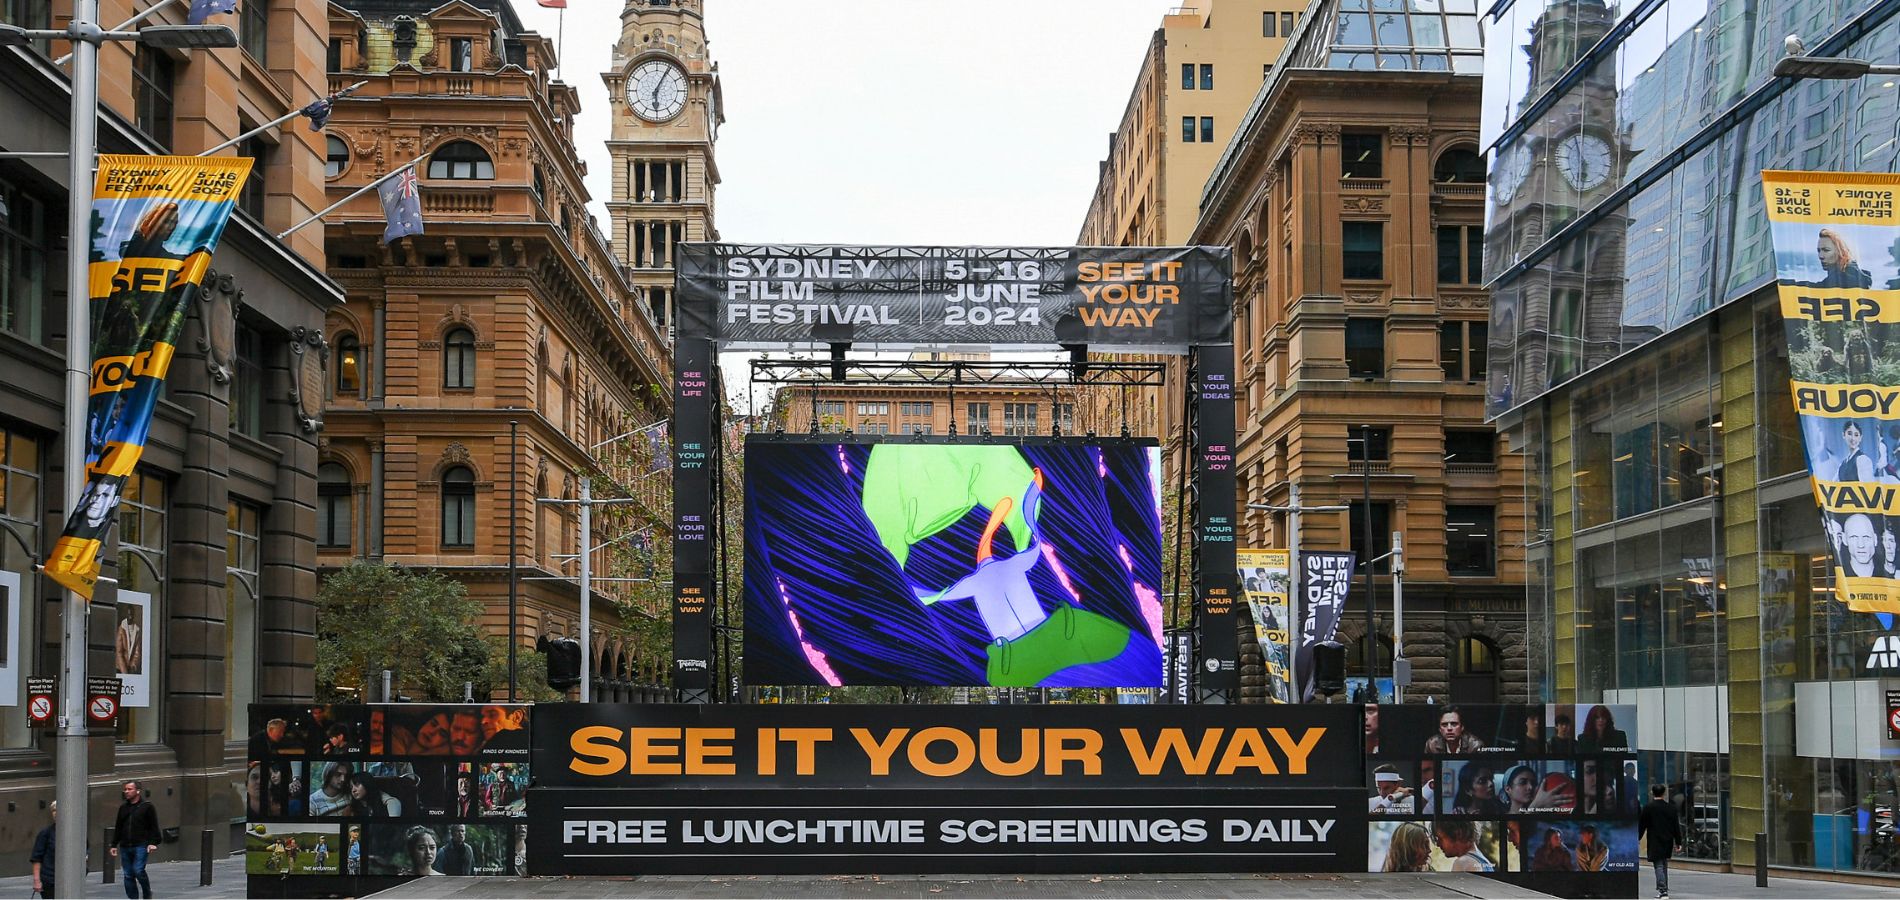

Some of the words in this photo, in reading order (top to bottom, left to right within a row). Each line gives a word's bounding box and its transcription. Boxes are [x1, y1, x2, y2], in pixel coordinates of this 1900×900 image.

[106, 176, 143, 184] FILM
[109, 169, 171, 177] SYDNEY
[194, 179, 235, 188] JUNE
[104, 184, 173, 192] FESTIVAL
[727, 257, 878, 279] SYDNEY
[1077, 261, 1147, 283] SEE
[1152, 261, 1183, 282] IT
[727, 281, 814, 301] FILM
[944, 283, 1041, 304] JUNE
[1078, 285, 1181, 305] YOUR
[727, 303, 900, 325] FESTIVAL
[944, 305, 1041, 326] 2024
[1078, 307, 1162, 328] WAY
[569, 725, 736, 777] SEE
[757, 727, 833, 776] IT
[849, 726, 1104, 777] YOUR
[1119, 727, 1327, 776] WAY
[563, 820, 668, 844] FREE
[682, 819, 925, 844] LUNCHTIME
[940, 818, 1208, 844] SCREENINGS
[1223, 819, 1337, 843] DAILY
